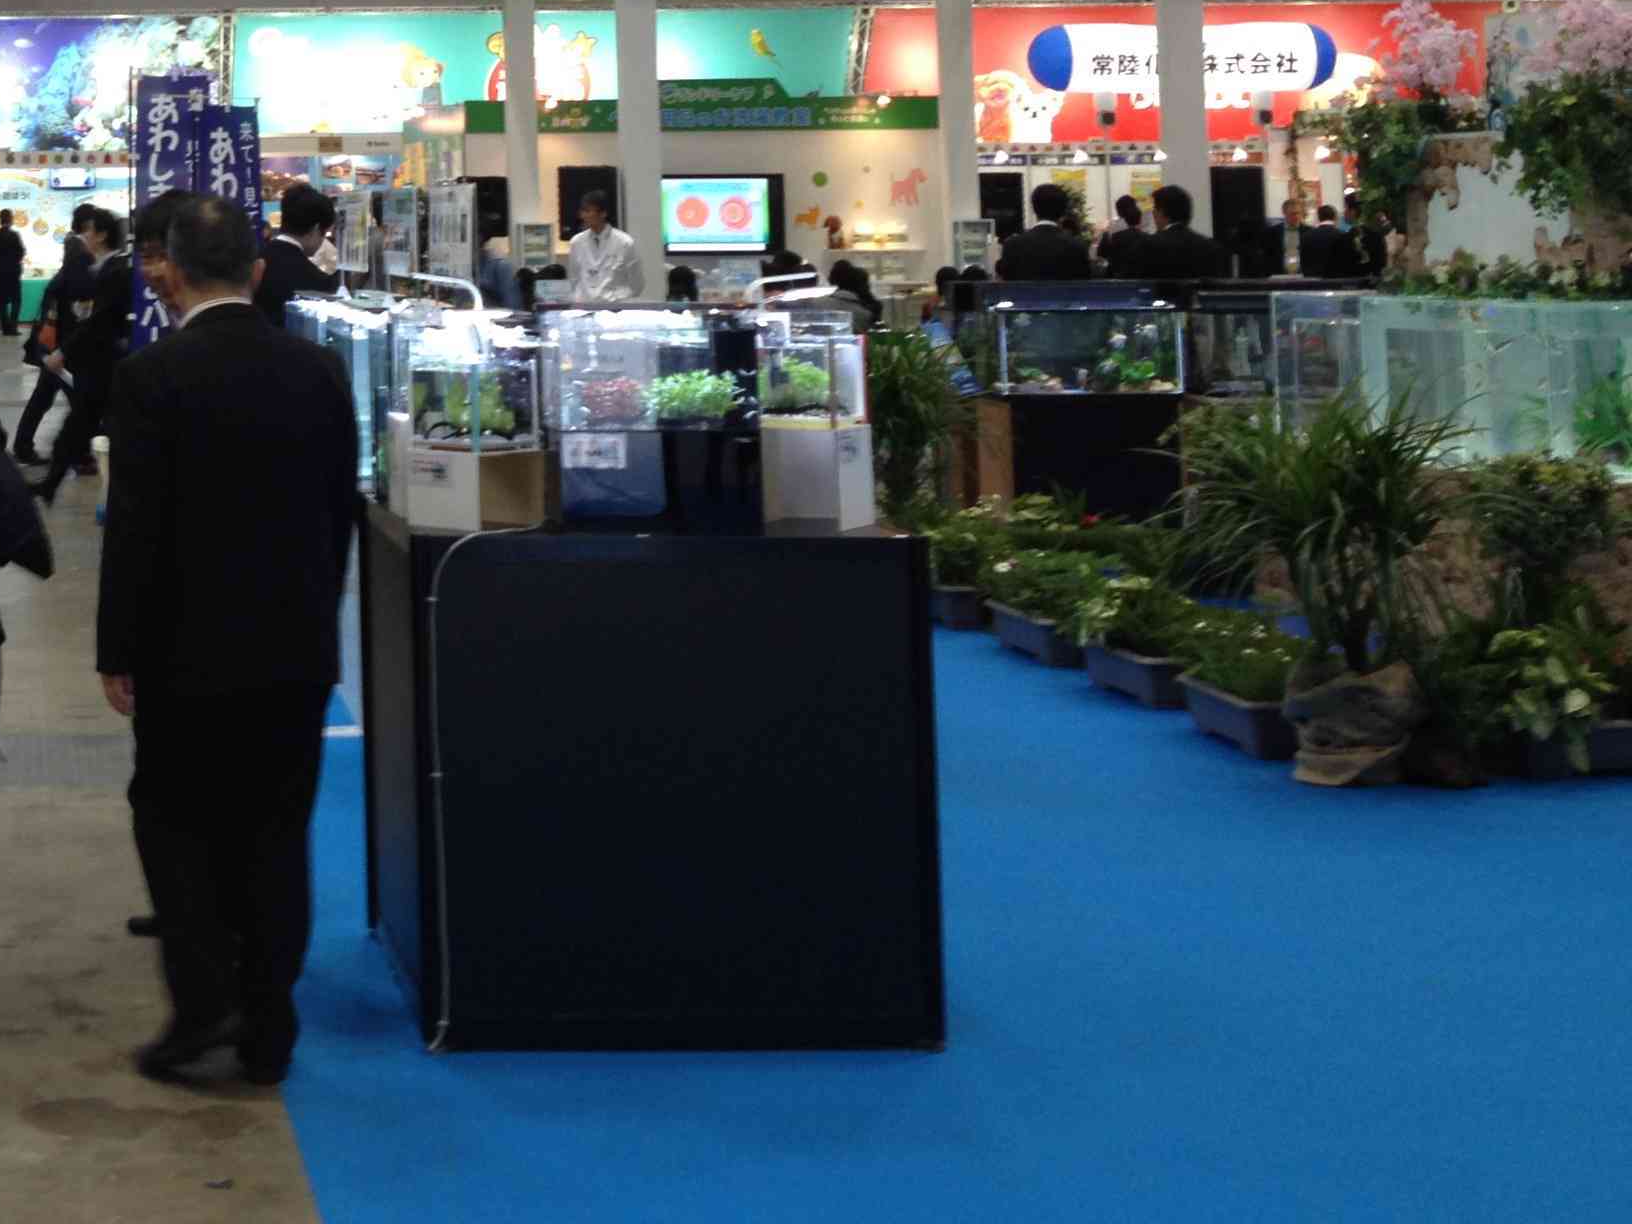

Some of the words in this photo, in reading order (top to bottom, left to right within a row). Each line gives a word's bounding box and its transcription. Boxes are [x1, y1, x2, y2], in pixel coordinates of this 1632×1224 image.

[1091, 52, 1299, 77] 常陸化株式会社
